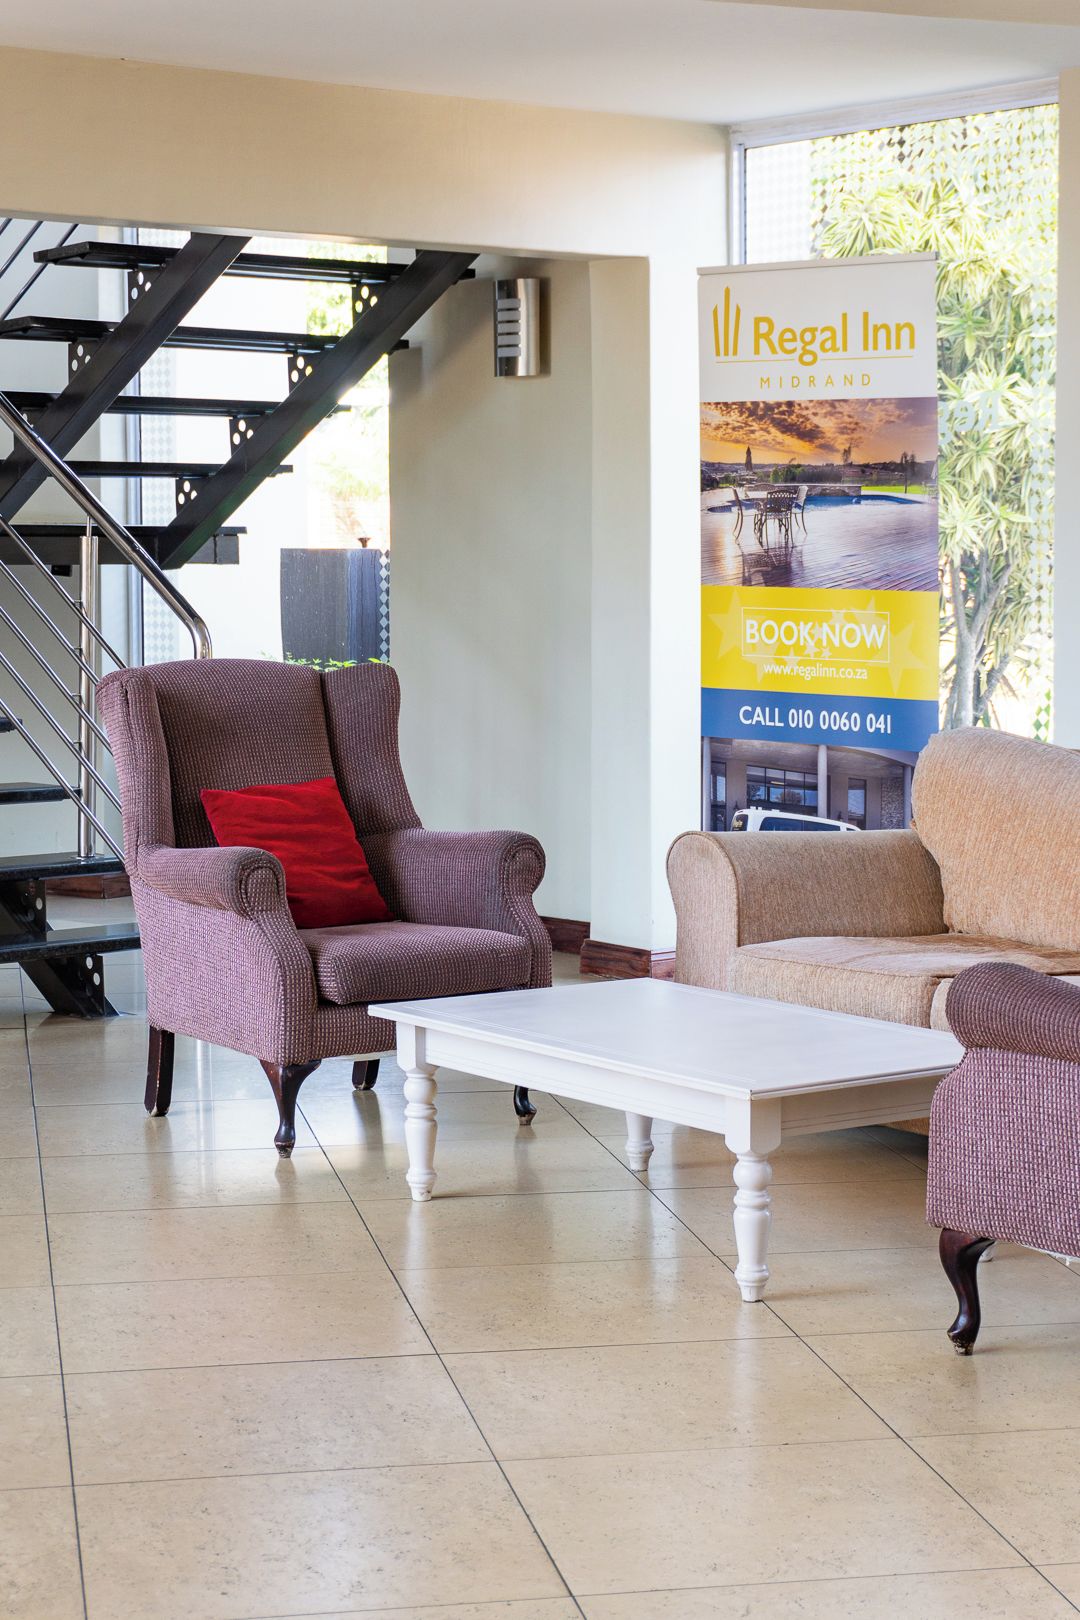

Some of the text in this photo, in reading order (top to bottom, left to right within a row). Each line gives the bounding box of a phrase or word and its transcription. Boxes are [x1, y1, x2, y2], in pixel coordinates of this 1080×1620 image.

[753, 311, 916, 367] Regal Inn
[760, 373, 871, 389] MIDRAND
[745, 619, 887, 649] BOOK NOW
[763, 662, 868, 681] www.regalinn.co.za
[739, 705, 892, 734] CALL 010 0060 041
